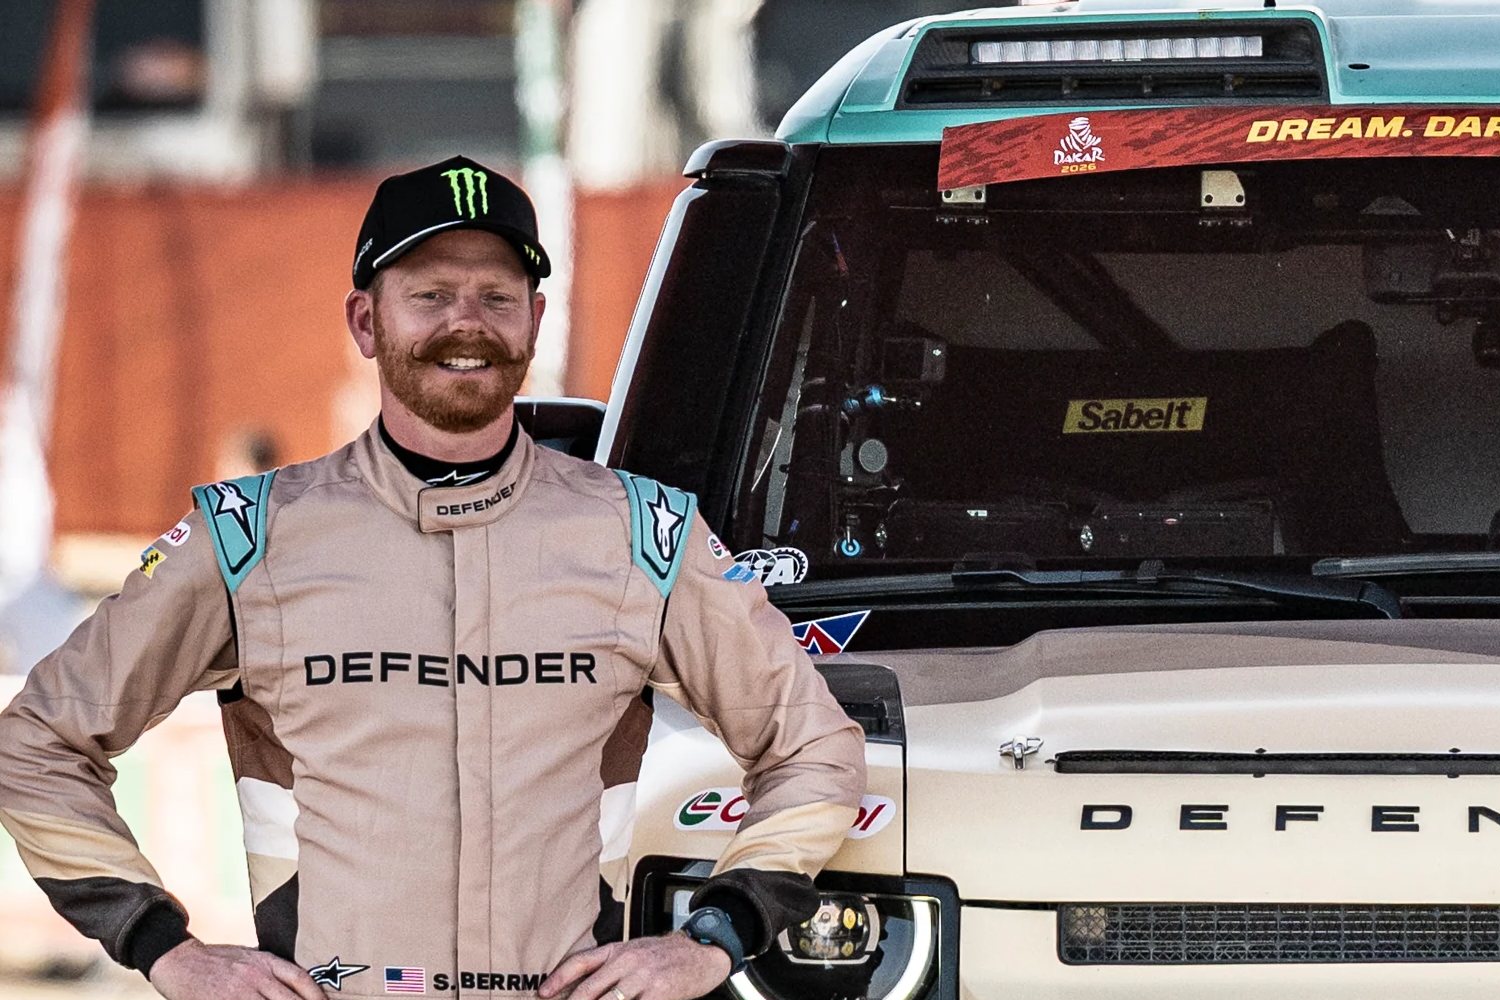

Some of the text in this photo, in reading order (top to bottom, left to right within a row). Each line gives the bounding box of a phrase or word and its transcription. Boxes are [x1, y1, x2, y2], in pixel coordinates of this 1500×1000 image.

[1245, 116, 1413, 143] DREAM.
[1053, 147, 1105, 165] DAKAR
[1061, 163, 1097, 173] 2026
[1078, 400, 1192, 431] Sabelt
[304, 651, 597, 687] DEFENDER
